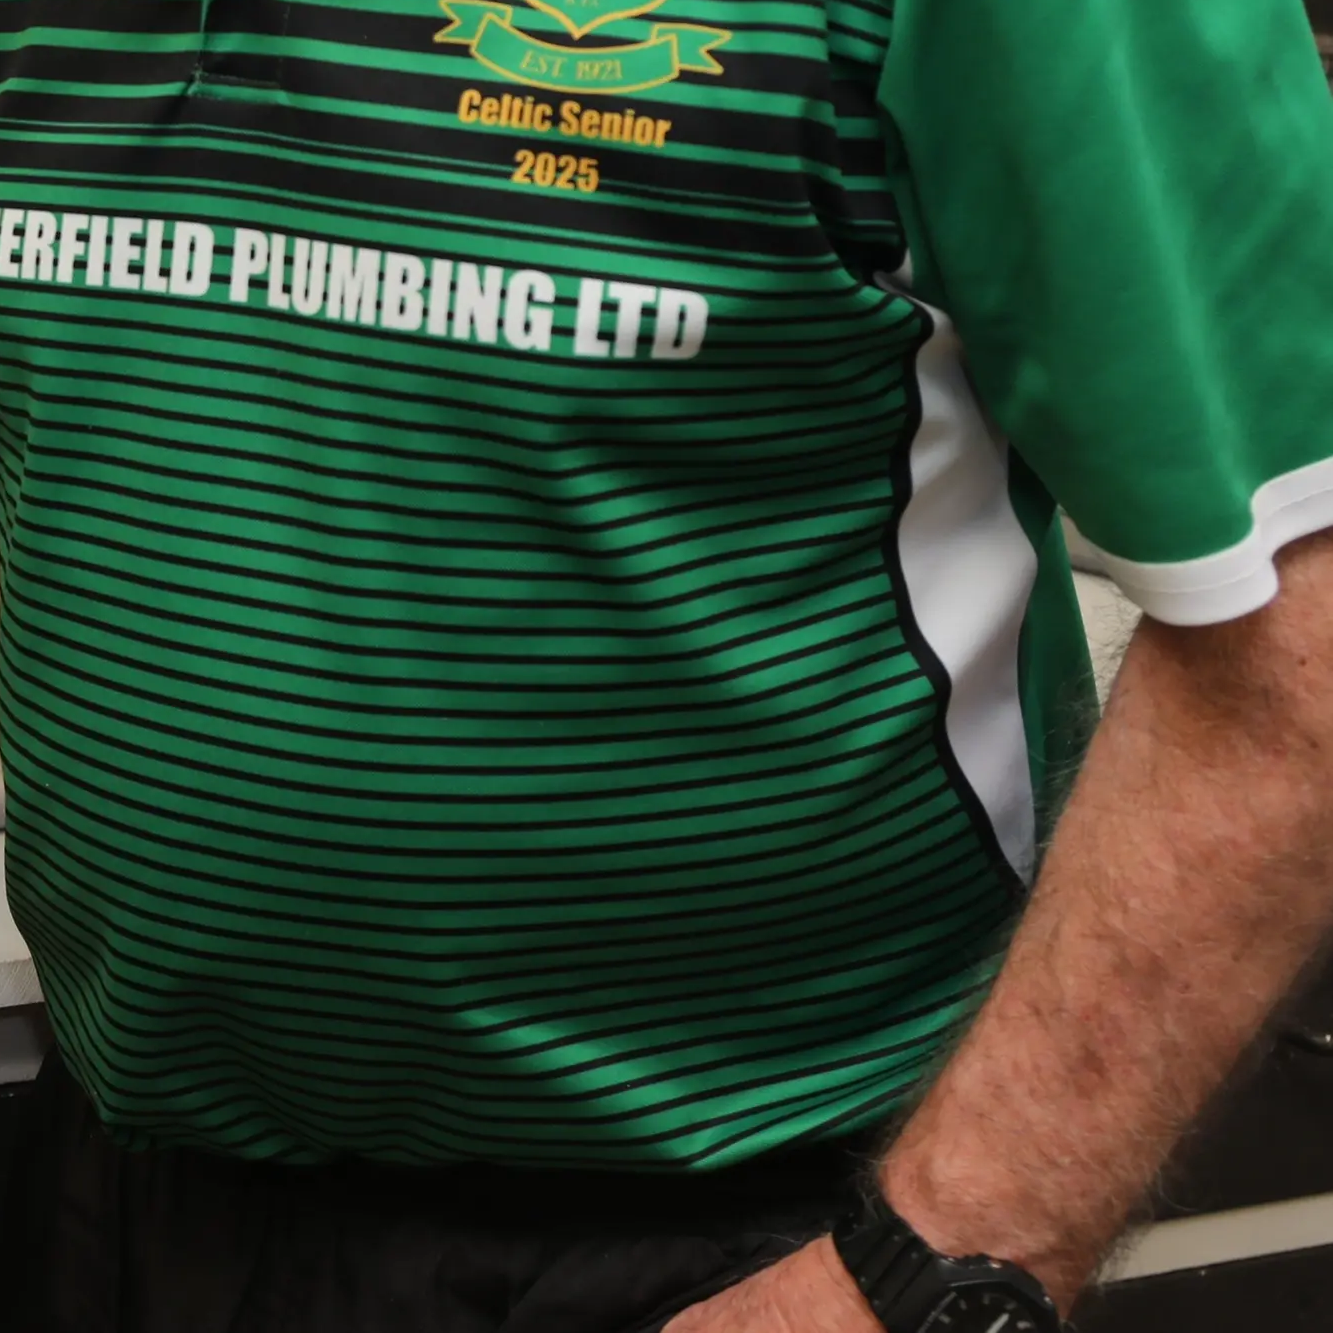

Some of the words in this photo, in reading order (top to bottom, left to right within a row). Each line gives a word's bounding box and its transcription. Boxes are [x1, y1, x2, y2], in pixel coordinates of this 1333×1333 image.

[520, 49, 567, 79] EST
[457, 88, 554, 133] Celtic
[558, 100, 673, 149] Senior
[510, 149, 601, 194] 2025
[228, 227, 556, 353] PLUMBING
[573, 277, 711, 362] LTD
